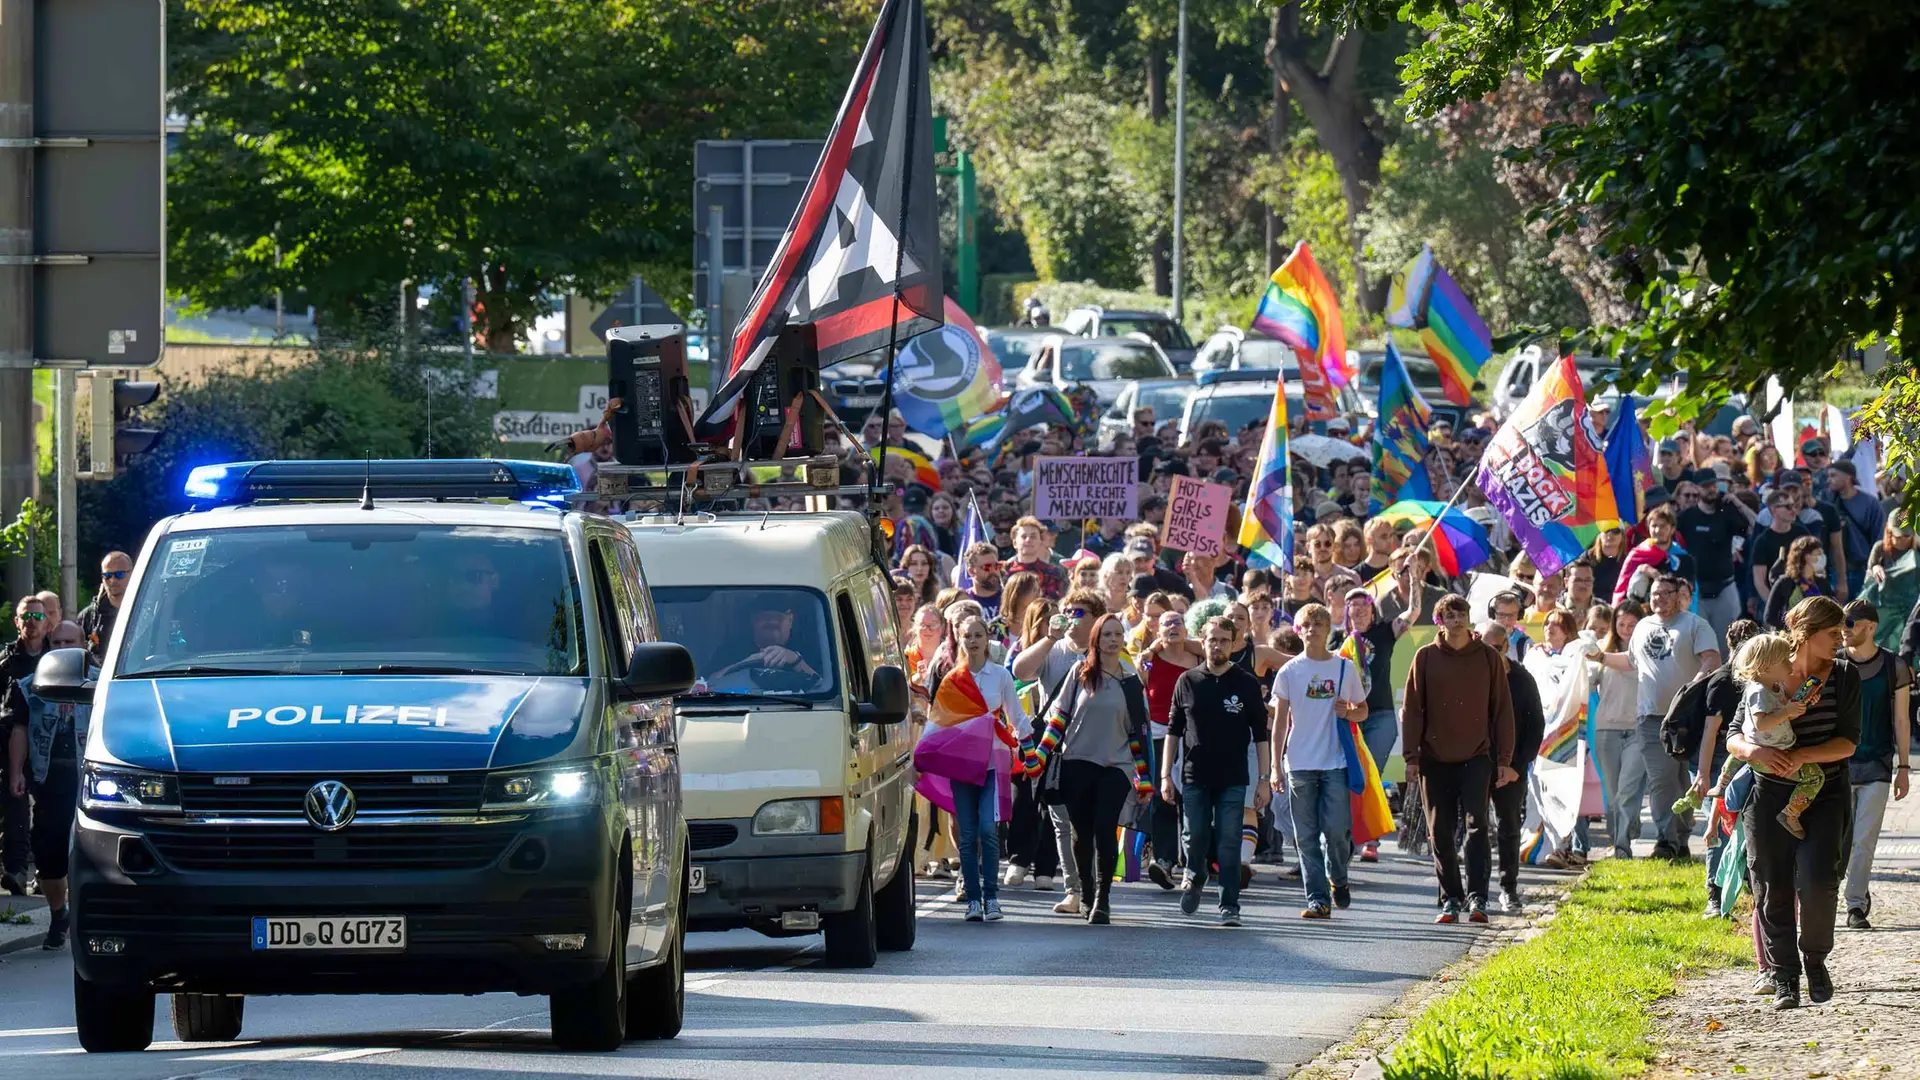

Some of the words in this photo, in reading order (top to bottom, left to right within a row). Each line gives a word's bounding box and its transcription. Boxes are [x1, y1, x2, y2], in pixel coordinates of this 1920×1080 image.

[1039, 461, 1135, 485] MENSCHENRECHTE
[1048, 485, 1081, 498] STATT
[1086, 486, 1126, 499] RECHTE
[1177, 480, 1204, 496] HOT
[1498, 460, 1550, 527] NAZIS
[1049, 499, 1128, 517] MENSCHEN
[1172, 498, 1212, 520] GIRLS
[1170, 514, 1199, 531] HATE
[1166, 527, 1219, 558] FASCISTS
[227, 704, 448, 729] POLIZEI
[269, 921, 301, 945] DD
[318, 921, 334, 945] Q
[340, 920, 402, 944] 6073
